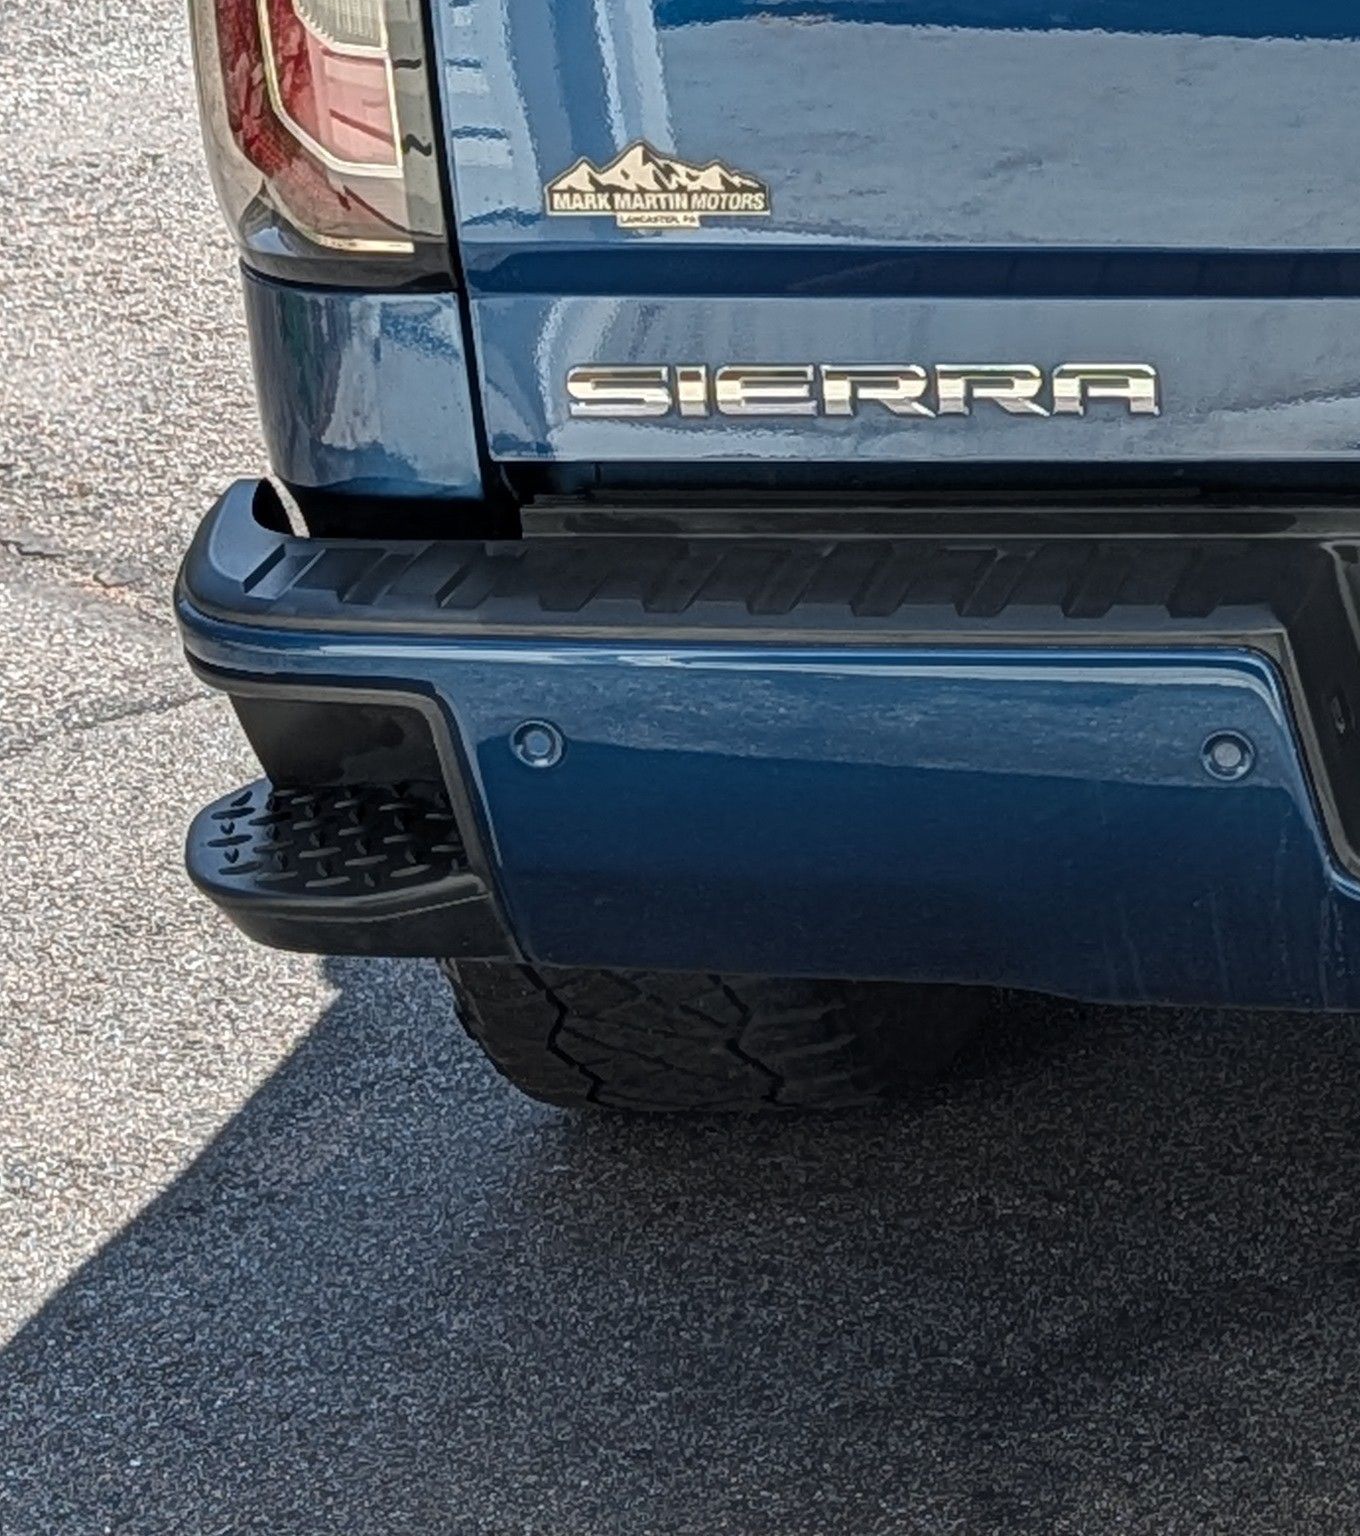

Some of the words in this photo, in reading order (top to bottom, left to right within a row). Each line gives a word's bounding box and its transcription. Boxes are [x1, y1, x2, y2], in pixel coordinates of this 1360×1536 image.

[552, 192, 611, 210] MARK
[614, 192, 688, 210] MARTIN
[691, 192, 765, 210] MOTORS
[567, 363, 1159, 417] SIERRA
